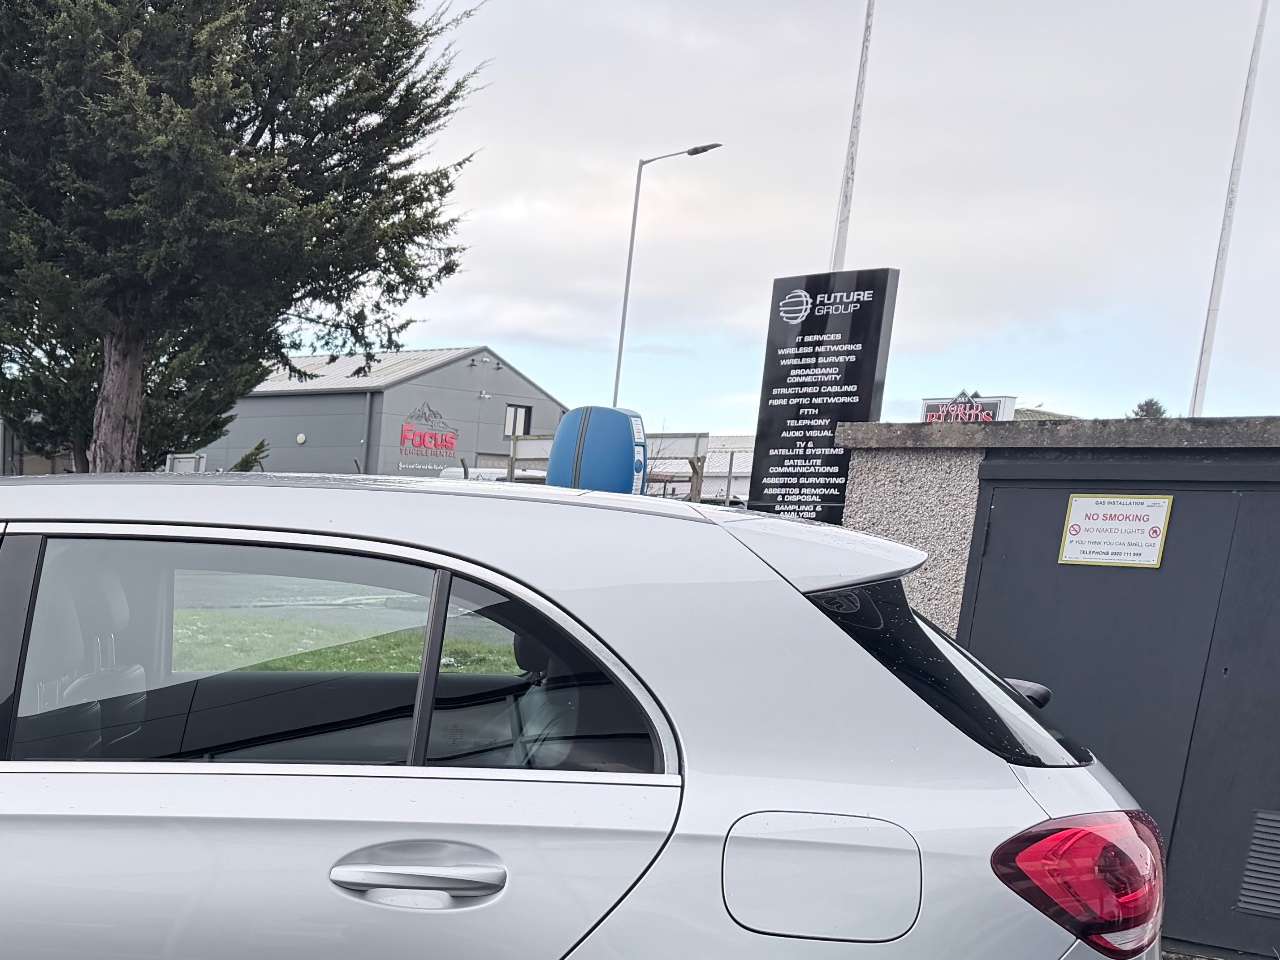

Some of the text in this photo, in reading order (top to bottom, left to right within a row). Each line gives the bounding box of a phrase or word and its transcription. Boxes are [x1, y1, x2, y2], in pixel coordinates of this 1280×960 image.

[817, 291, 873, 304] FUTURE
[815, 303, 860, 315] GROUP
[804, 333, 842, 342] SERVICES
[778, 343, 862, 355] WIRELESS NETWORKS
[780, 355, 856, 366] WIRELESS SURVEYS
[790, 367, 839, 376] BROADBAND
[786, 374, 842, 383] CONNECTIVITY
[772, 384, 858, 395] STRUCTURED CABLING
[789, 397, 810, 405] OPTIC
[812, 396, 860, 404] NETWORKS
[939, 402, 983, 414] WORLD
[787, 419, 831, 427] TELEPHONY
[806, 447, 844, 455] SYSTEMS
[763, 487, 840, 495] ASBESTOS REMOVAL
[784, 494, 822, 502] DISPOSAL
[1084, 512, 1150, 523] NO SMOKING
